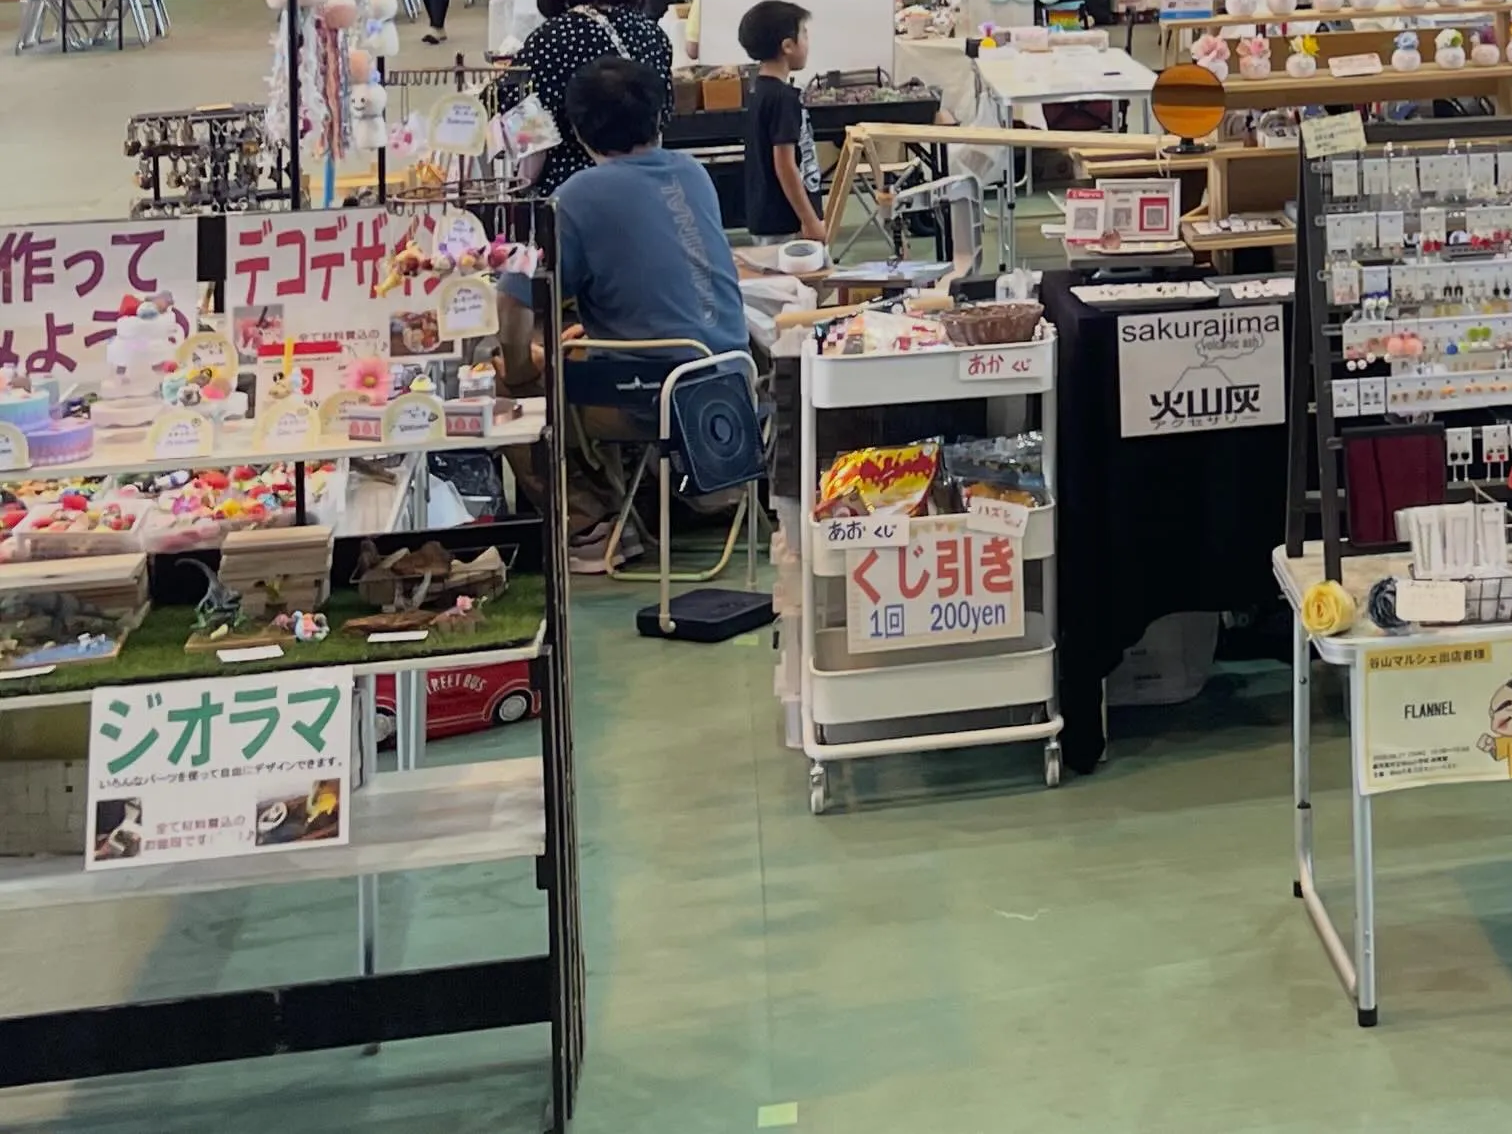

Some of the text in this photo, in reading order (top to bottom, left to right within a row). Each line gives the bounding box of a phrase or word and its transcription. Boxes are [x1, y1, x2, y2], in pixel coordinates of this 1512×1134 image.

[0, 229, 165, 304] 作って
[1121, 313, 1281, 344] sakurajima
[967, 353, 1032, 376] あか くじ
[1149, 384, 1261, 421] 火山灰
[827, 521, 898, 543] あお くじ
[852, 534, 1015, 606] くじ引き
[870, 599, 1007, 638] 1回 200yen
[1404, 700, 1457, 719] FLANNEL
[99, 685, 342, 776] ジオラマ
